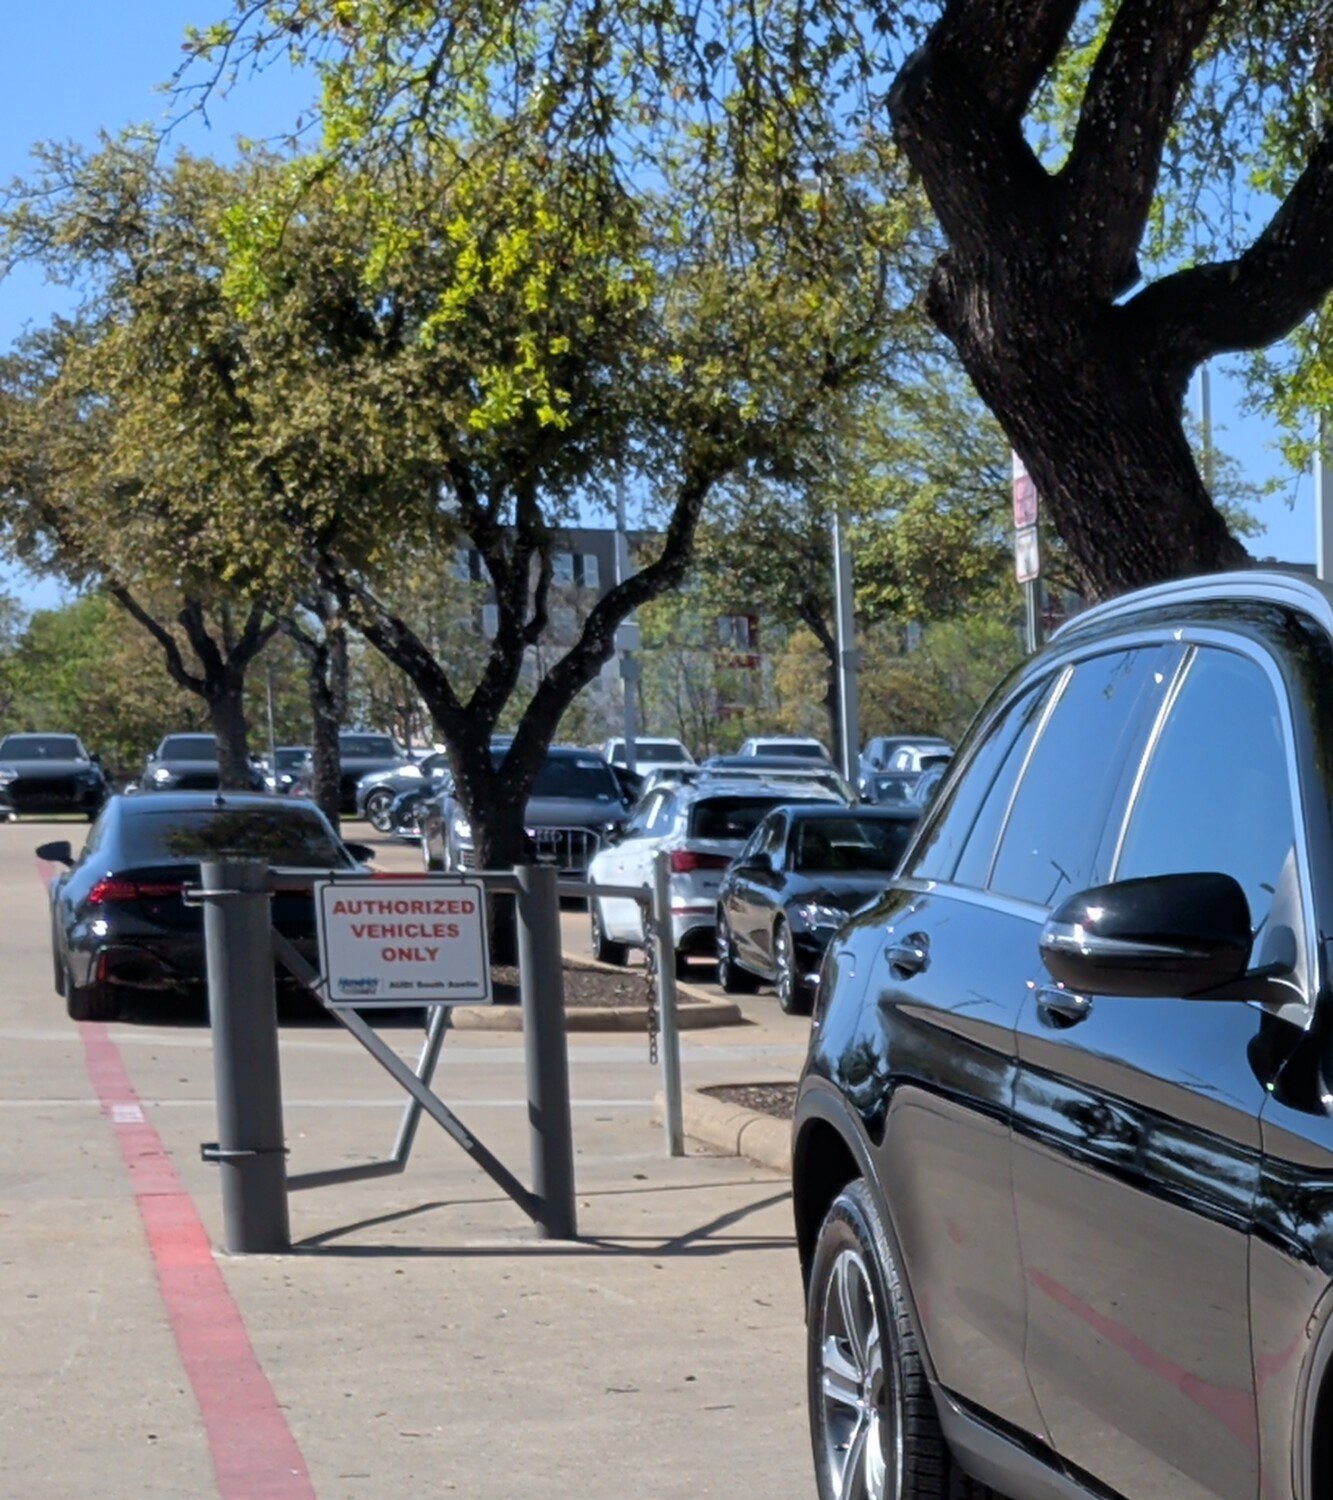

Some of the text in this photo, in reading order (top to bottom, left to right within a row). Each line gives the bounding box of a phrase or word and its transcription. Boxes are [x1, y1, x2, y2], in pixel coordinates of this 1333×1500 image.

[331, 900, 475, 915] AUTHORIZED
[350, 923, 460, 939] VEHICLES
[381, 947, 439, 962] ONLY
